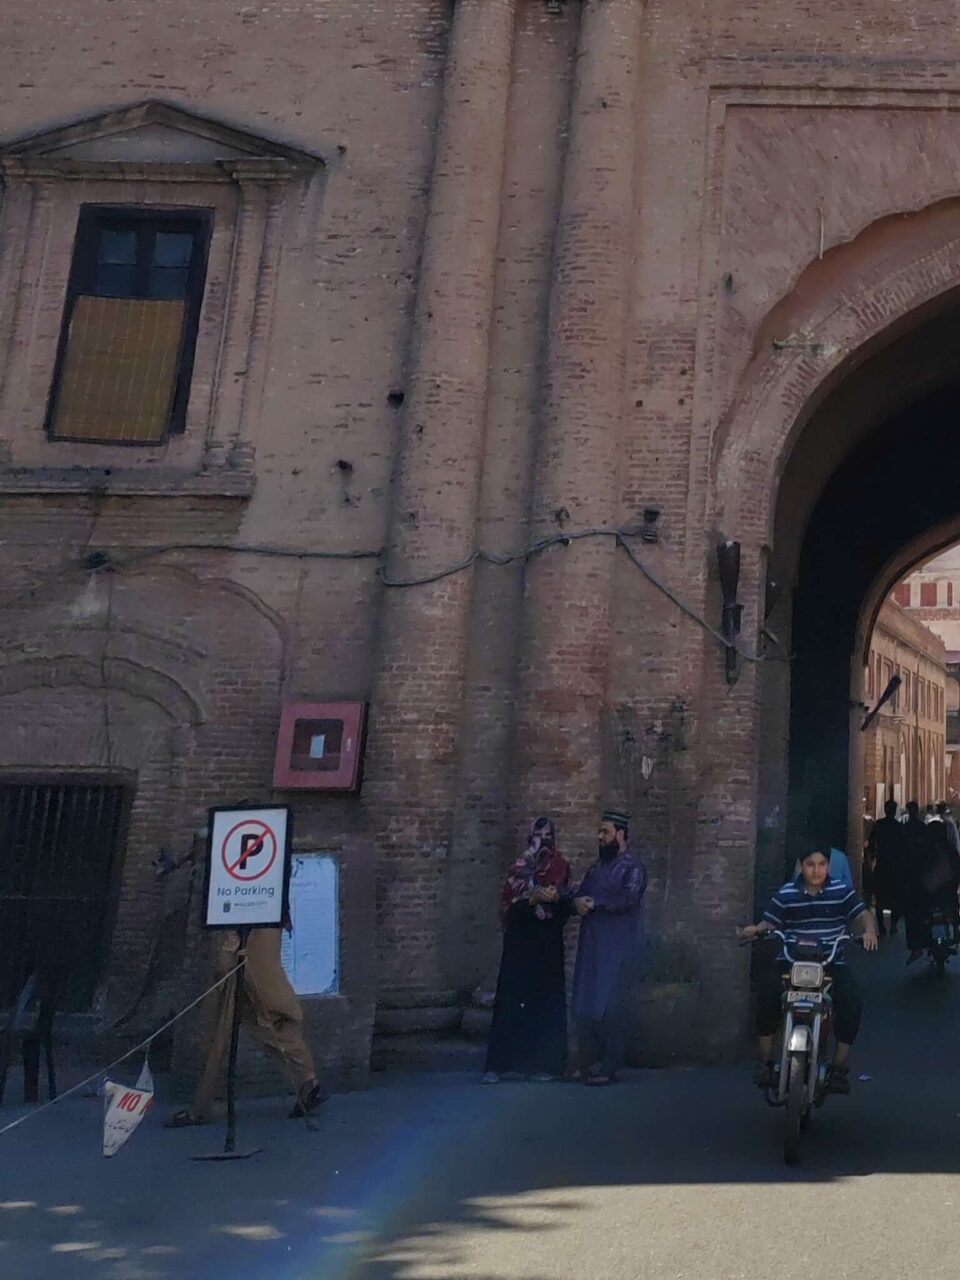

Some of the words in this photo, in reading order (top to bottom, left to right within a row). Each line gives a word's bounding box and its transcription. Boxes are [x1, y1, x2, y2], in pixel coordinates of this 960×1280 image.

[217, 887, 232, 897] No
[234, 885, 275, 898] Parking
[116, 1091, 143, 1113] NO
